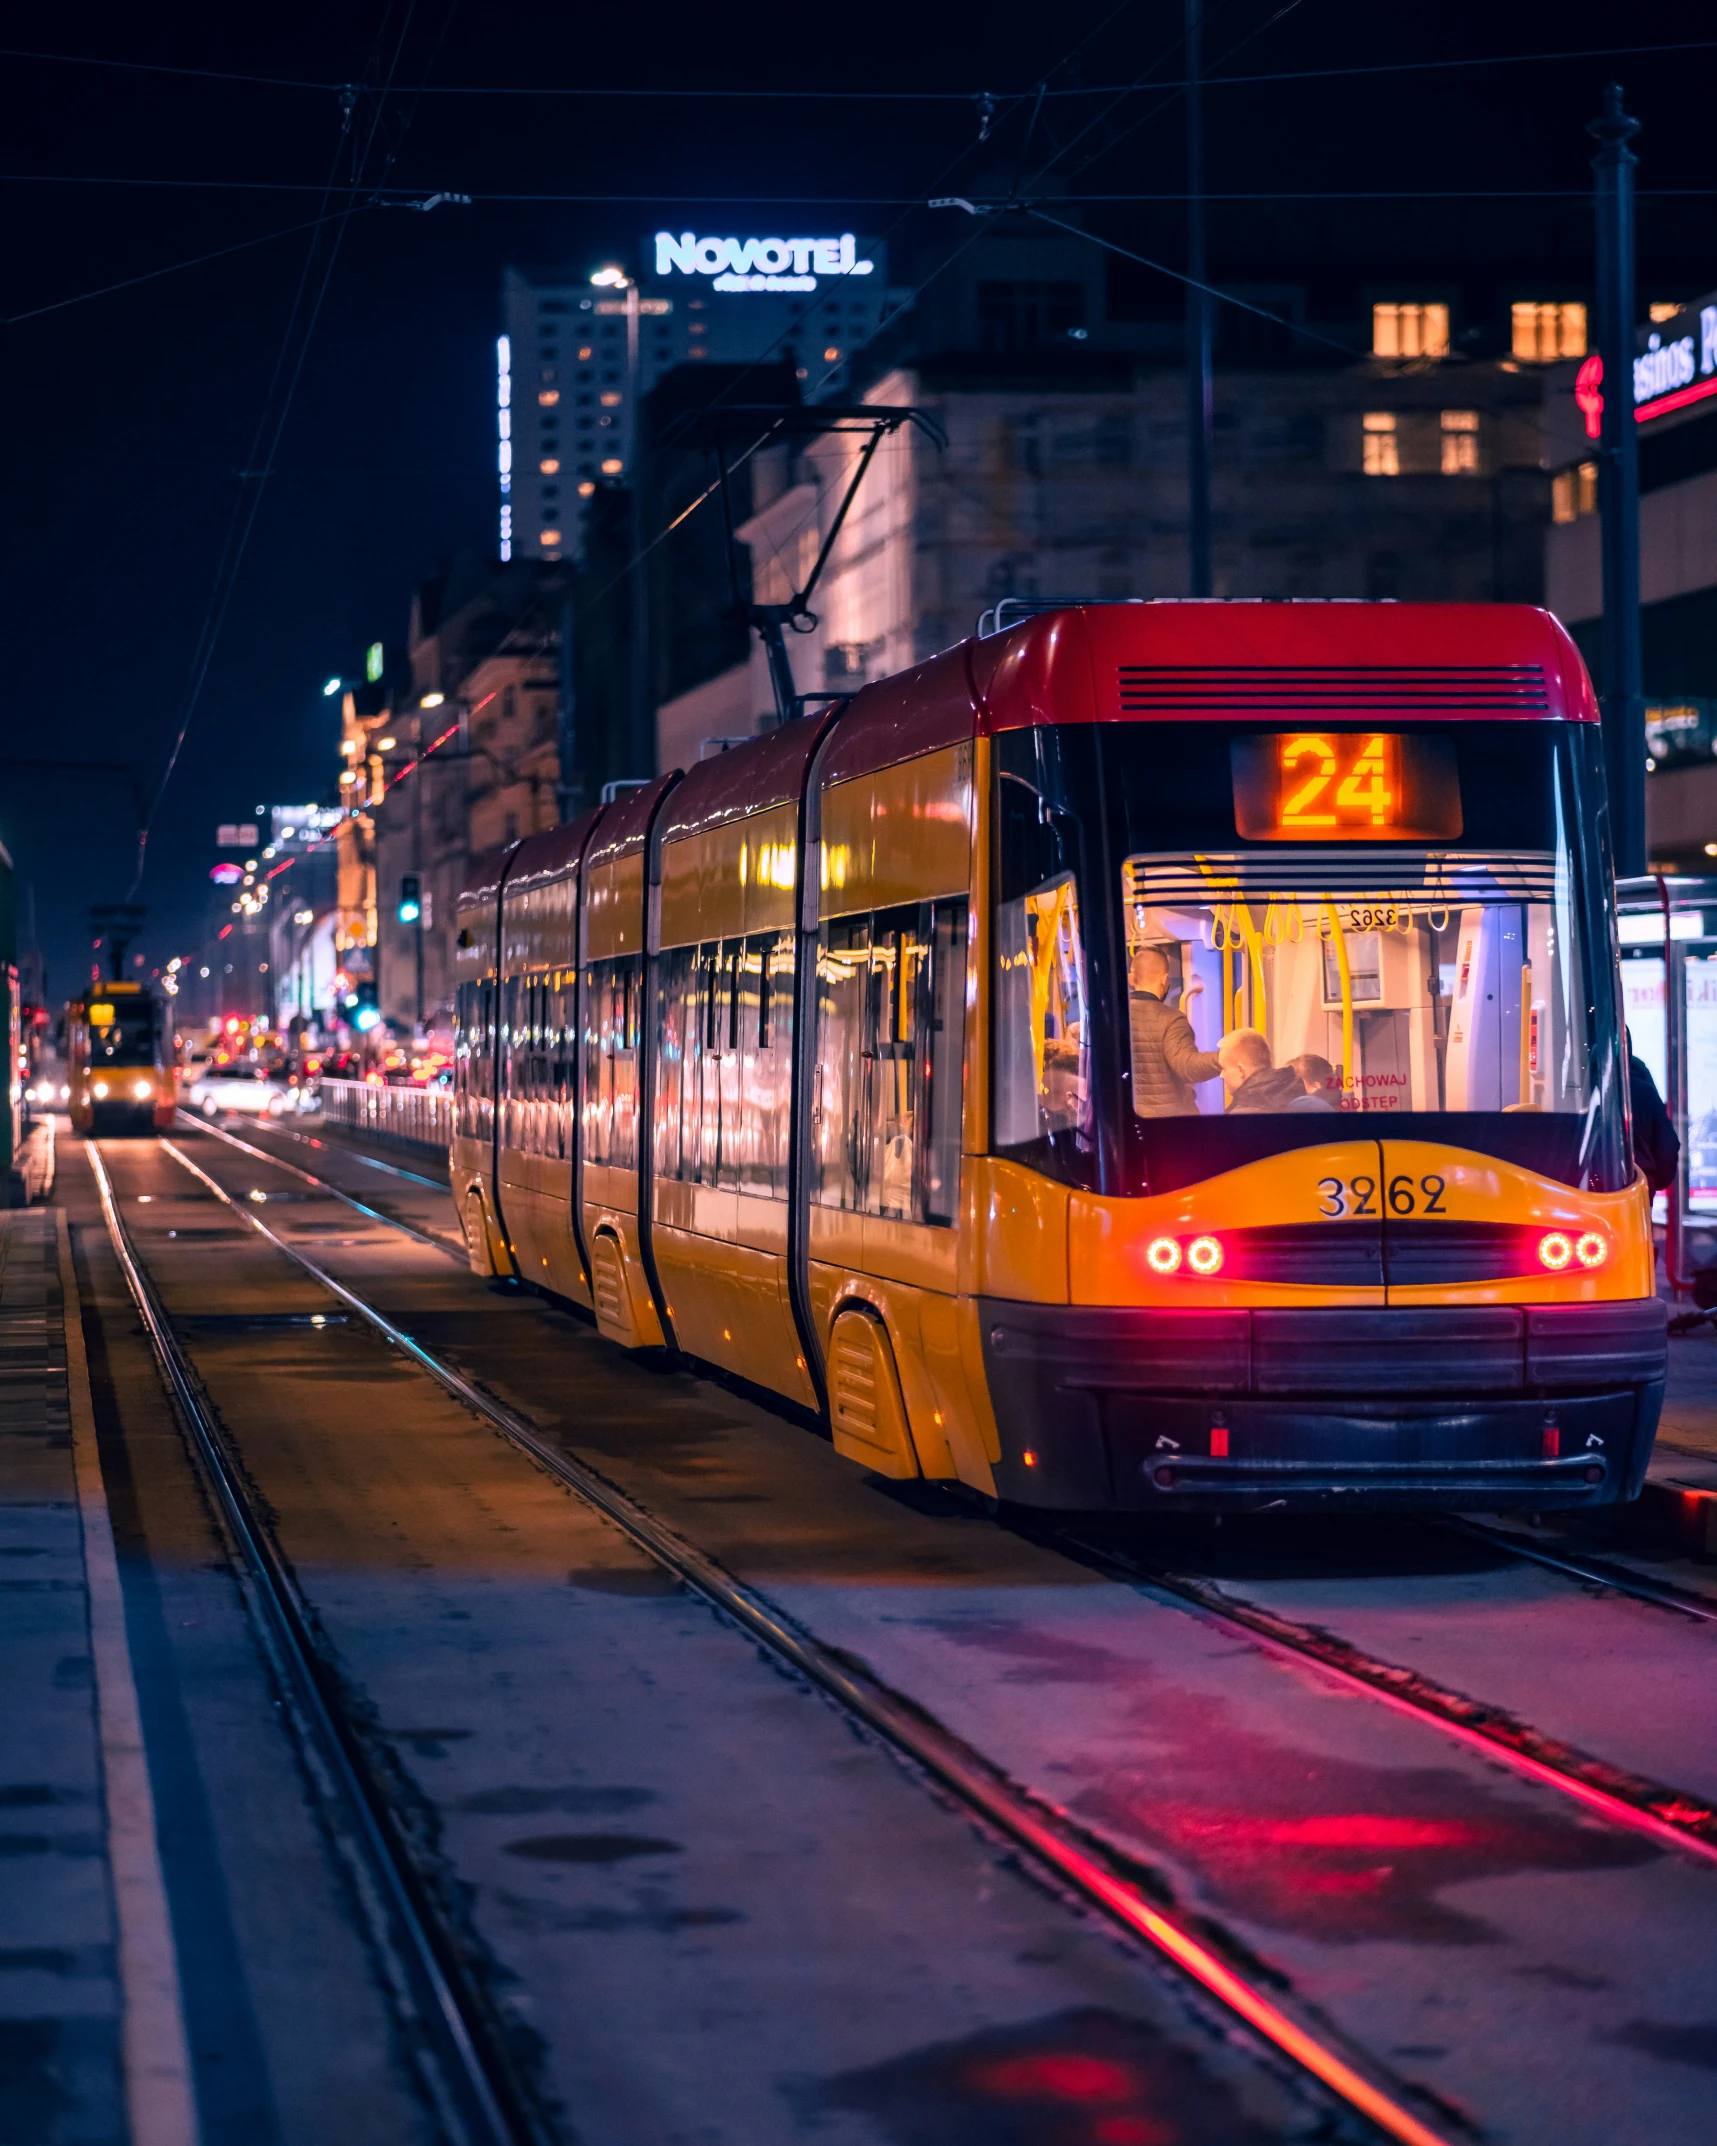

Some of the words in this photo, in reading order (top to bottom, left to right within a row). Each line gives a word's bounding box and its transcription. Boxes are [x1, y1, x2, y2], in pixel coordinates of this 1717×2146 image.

[655, 231, 874, 275] NOVOTEL
[1282, 737, 1392, 826] 24
[1325, 1073, 1407, 1090] ZACHOWAJ
[1318, 1175, 1447, 1217] 3262
